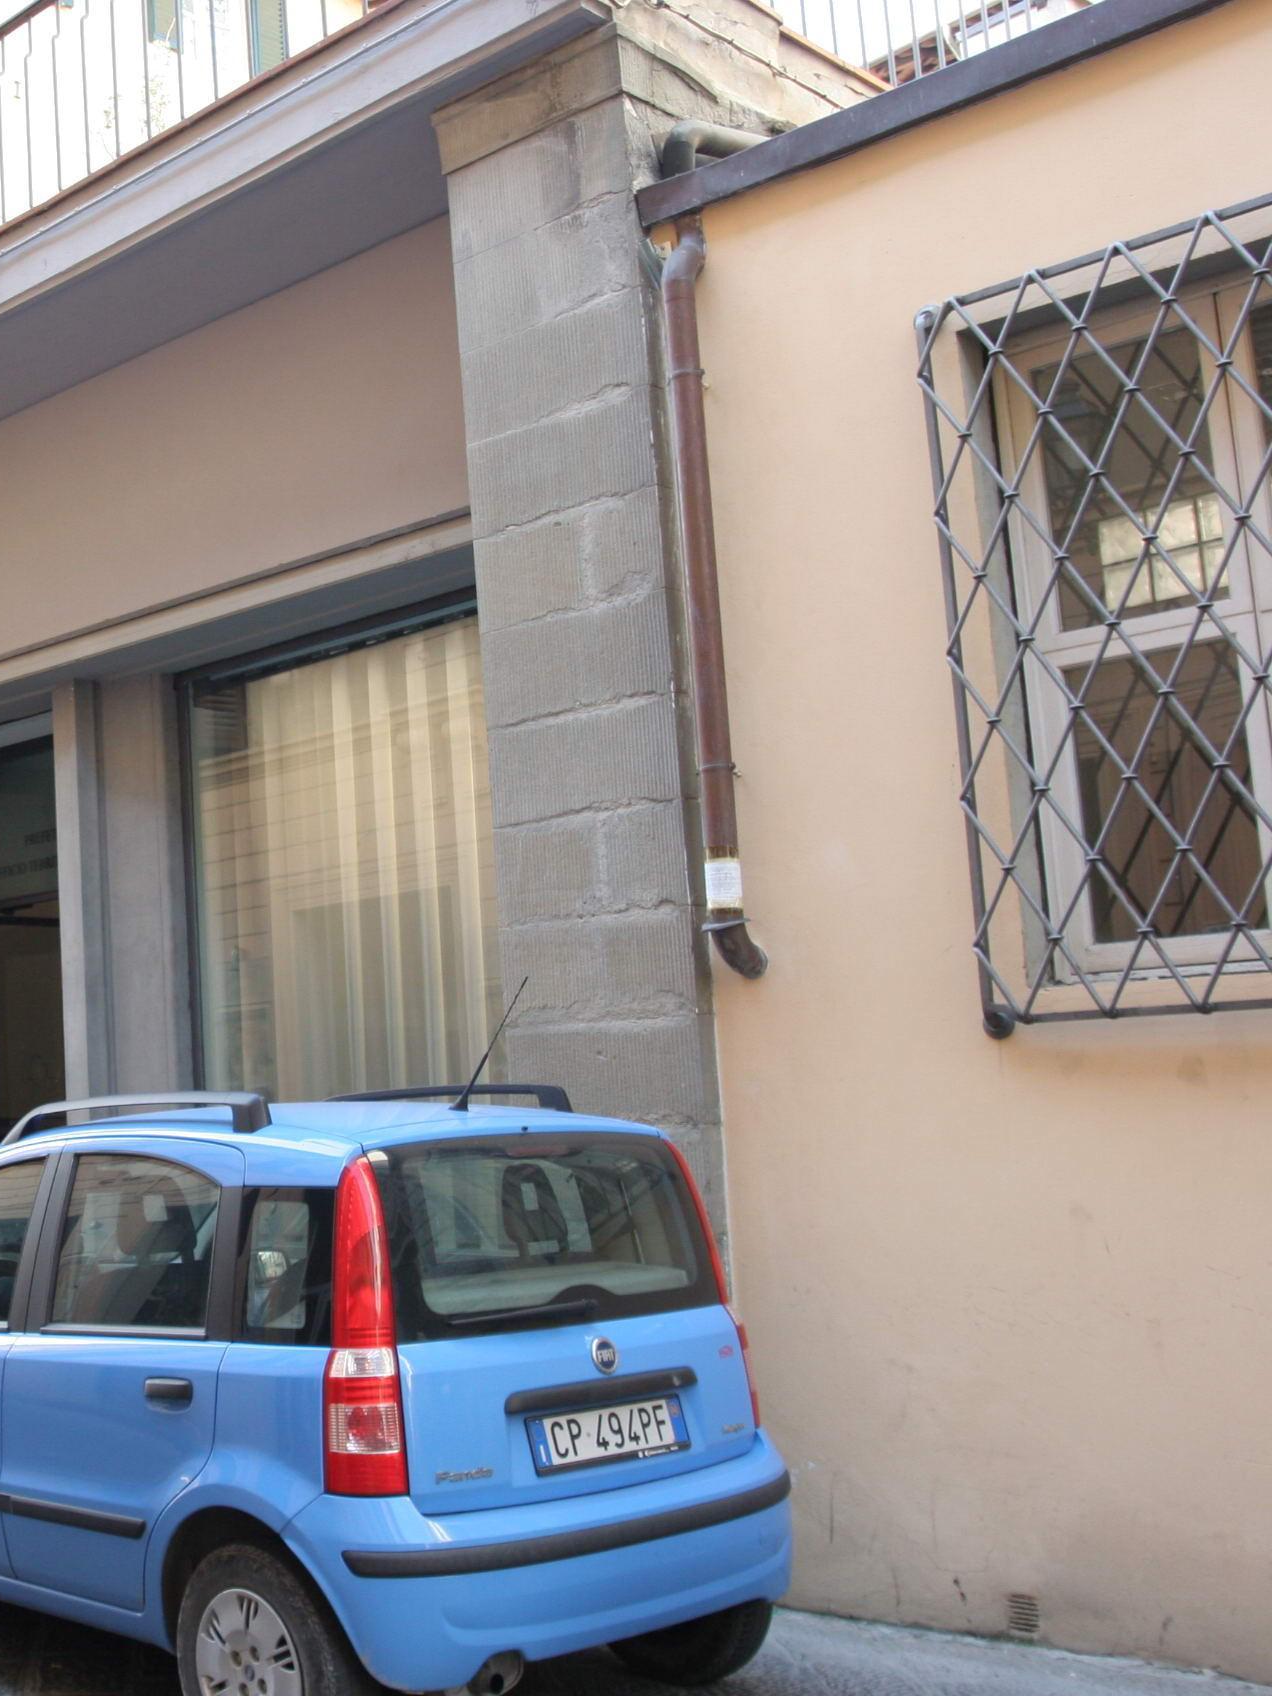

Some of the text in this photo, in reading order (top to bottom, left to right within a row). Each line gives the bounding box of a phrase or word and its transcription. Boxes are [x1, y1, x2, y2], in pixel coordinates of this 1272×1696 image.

[597, 1349, 615, 1362] FIAT
[550, 1404, 666, 1459] CP 494PF
[435, 1467, 494, 1485] Panda
